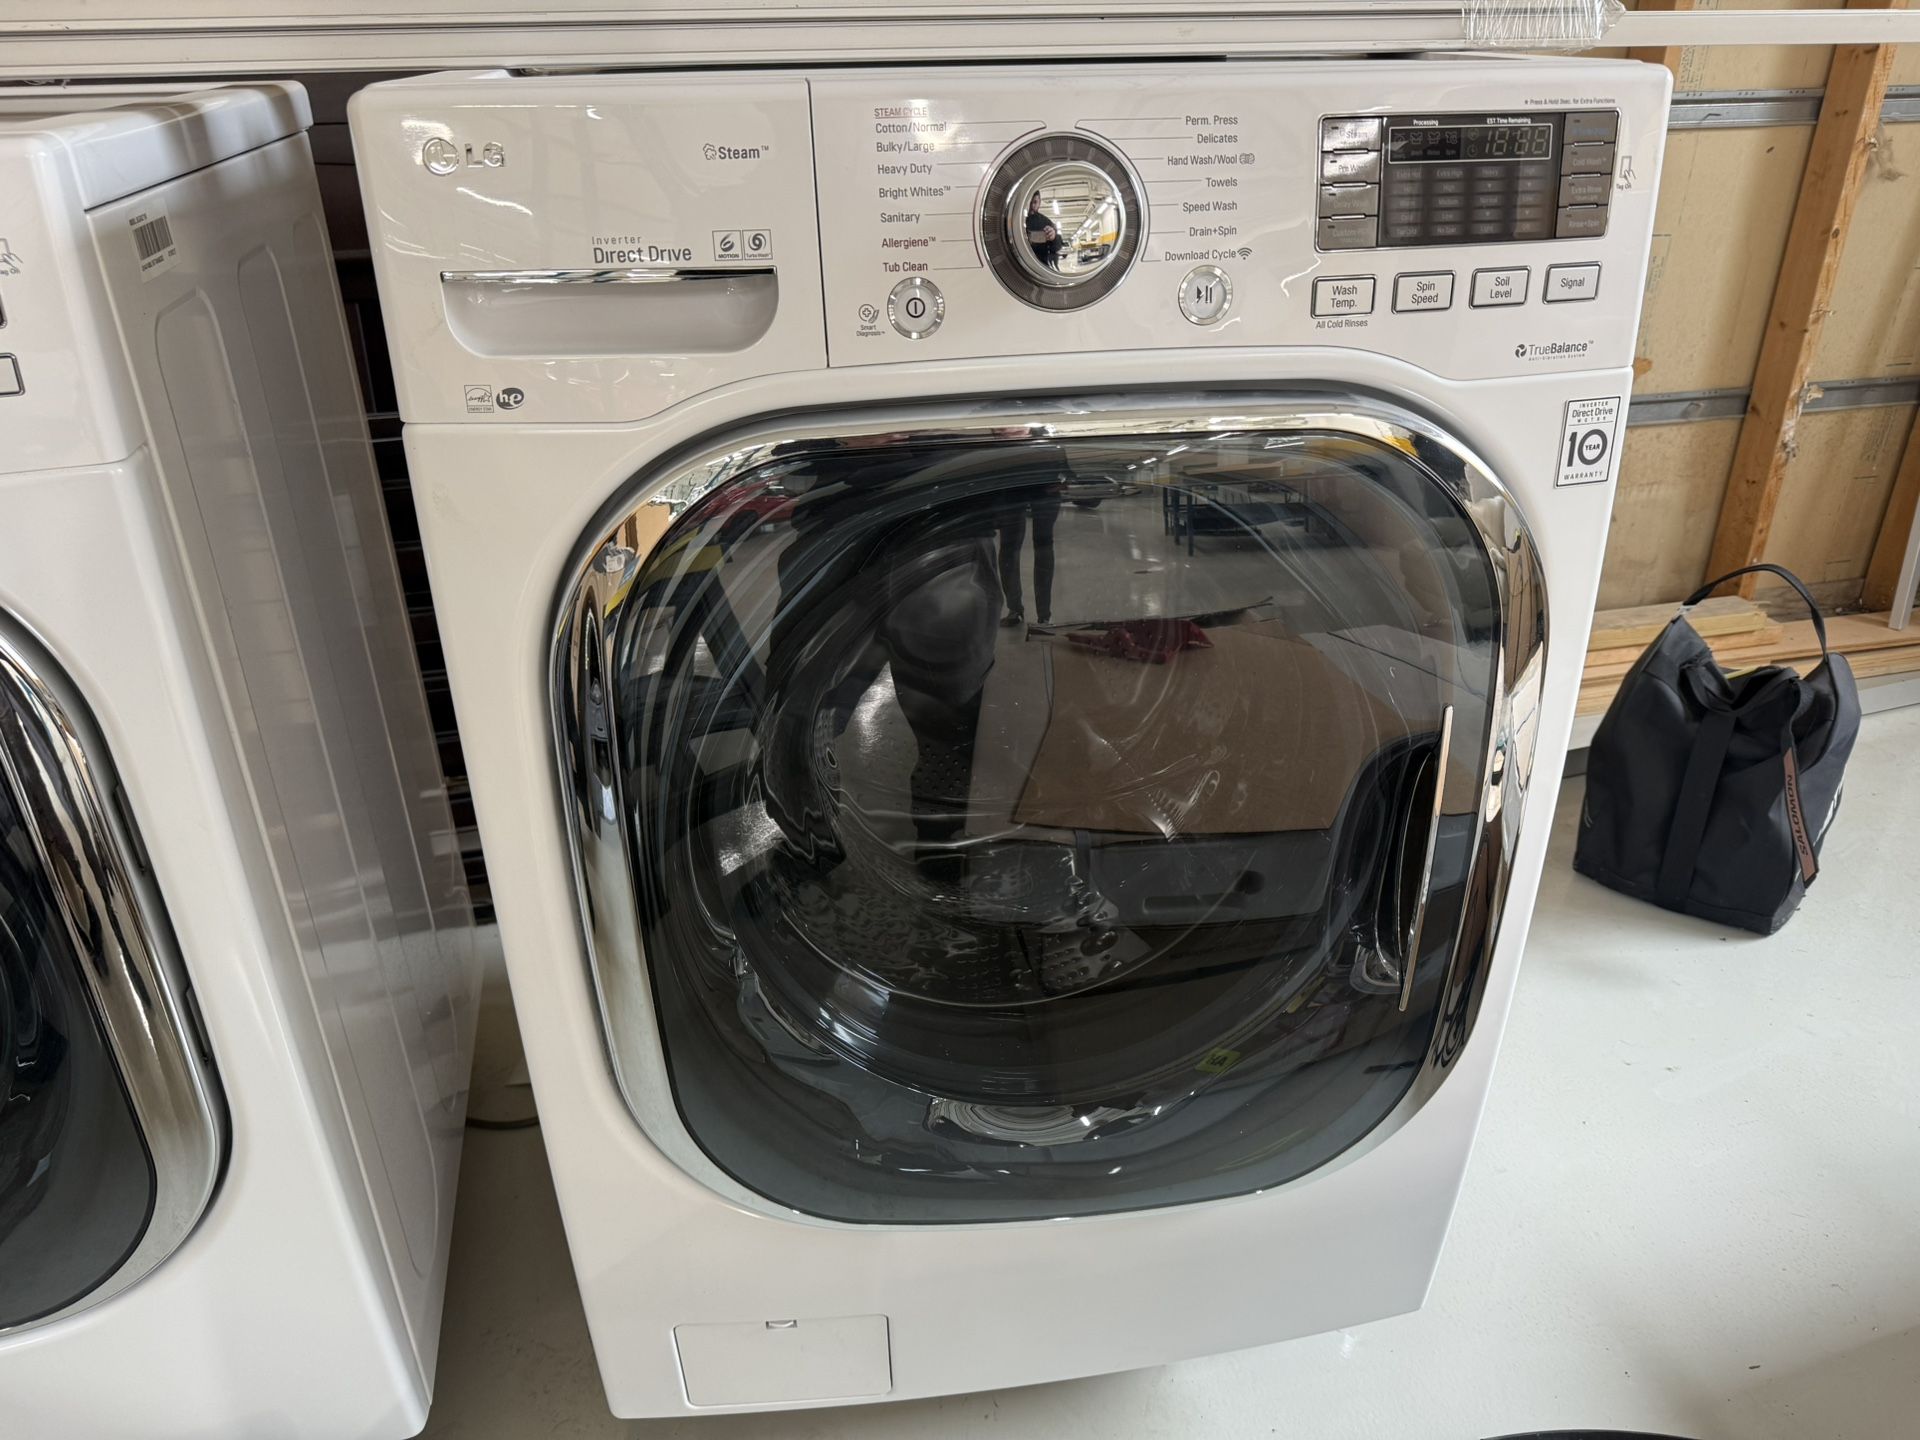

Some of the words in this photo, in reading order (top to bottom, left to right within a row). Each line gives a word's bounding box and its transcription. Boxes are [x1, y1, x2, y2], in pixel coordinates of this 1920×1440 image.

[874, 107, 901, 116] STEAM
[903, 106, 927, 116] CYCLE
[1185, 115, 1211, 126] Perm.
[1213, 114, 1238, 125] Press
[1508, 116, 1532, 124] Remaining
[875, 122, 947, 134] Cotton/Normal
[1197, 133, 1238, 144] Delicates
[876, 142, 935, 153] Bulky/Large
[464, 142, 505, 168] LG
[1167, 156, 1188, 166] Hand
[1190, 154, 1238, 165] Wash/Wool
[877, 164, 908, 175] Heavy
[910, 163, 932, 174] Duty
[1204, 177, 1238, 188] Towels
[879, 187, 908, 200] Bright
[1182, 202, 1210, 214] Speed
[1212, 201, 1238, 211] Wash
[880, 212, 920, 224] Sanitary
[1189, 226, 1237, 237] Drain+Spin
[591, 236, 642, 245] Inverter
[593, 247, 645, 264] Direct
[648, 245, 692, 262] Drive
[1164, 250, 1210, 261] Download
[1212, 249, 1236, 260] Cycle
[883, 262, 900, 272] Tub
[902, 261, 928, 272] Clean
[1495, 276, 1510, 287] Soil
[1560, 277, 1585, 289] Signal
[1332, 285, 1358, 296] Wash
[1416, 282, 1436, 294] Spin
[1490, 288, 1512, 299] Level
[1331, 298, 1358, 309] Temp.
[1411, 294, 1438, 305] Speed
[1316, 320, 1326, 329] All
[1327, 320, 1344, 328] Cold
[1344, 319, 1368, 328] Rinses
[1572, 409, 1594, 418] Direct
[1594, 407, 1614, 416] Drive
[1567, 428, 1608, 466] 10
[1564, 471, 1602, 480] WARRANTY
[1786, 774, 1809, 856] SALOMON
